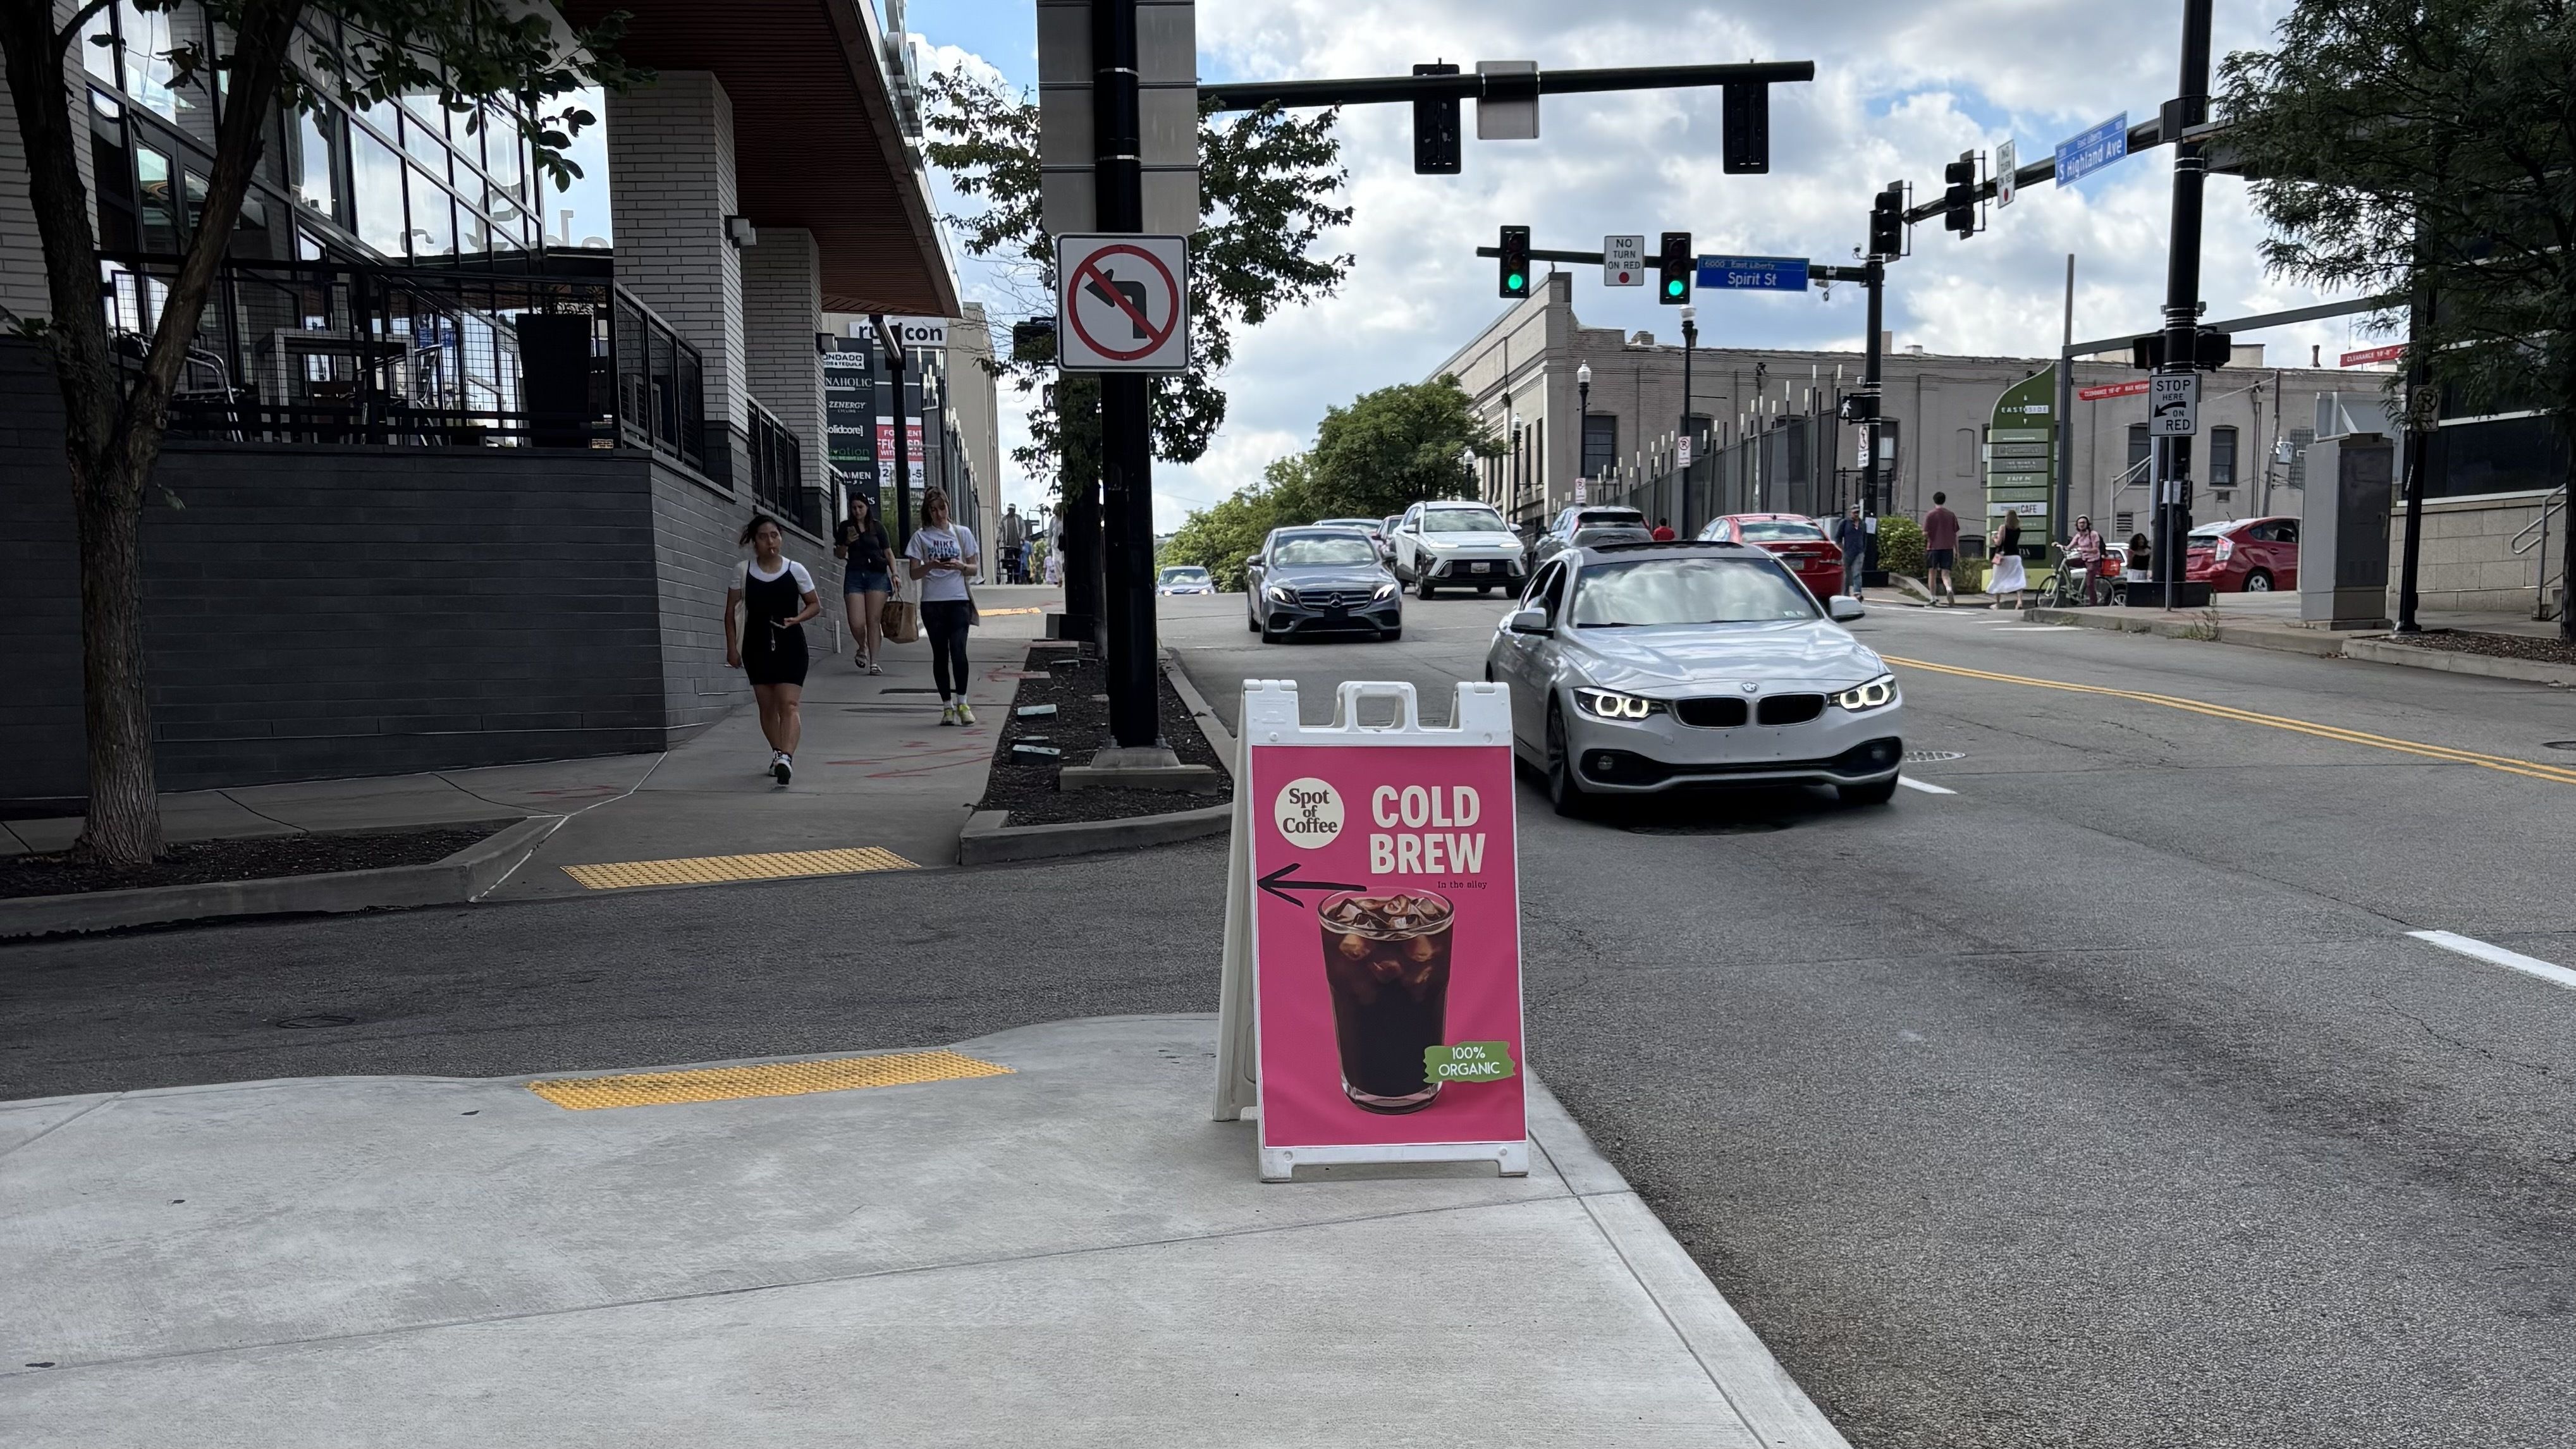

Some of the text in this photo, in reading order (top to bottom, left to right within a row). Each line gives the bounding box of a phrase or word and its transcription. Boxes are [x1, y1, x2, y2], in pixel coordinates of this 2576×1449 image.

[2059, 139, 2122, 181] S Highland Ave
[1616, 238, 1632, 248] NO
[1614, 250, 1636, 259] TURN
[1608, 261, 1640, 269] ON RED
[1731, 260, 1747, 269] East
[1750, 261, 1775, 270] Liberty
[1728, 272, 1777, 288] Spirit St
[2156, 379, 2191, 391] STOP
[828, 401, 866, 409] ZENERGY
[2166, 419, 2190, 431] RED
[2020, 504, 2037, 513] CAFE
[1289, 788, 1330, 808] Spot
[1303, 805, 1318, 817] of
[1371, 785, 1480, 828] COLD
[1282, 817, 1337, 833] Coffee
[1370, 833, 1486, 874] BREW
[1452, 1046, 1486, 1060] 100%
[1438, 1061, 1500, 1077] ORGANIC
